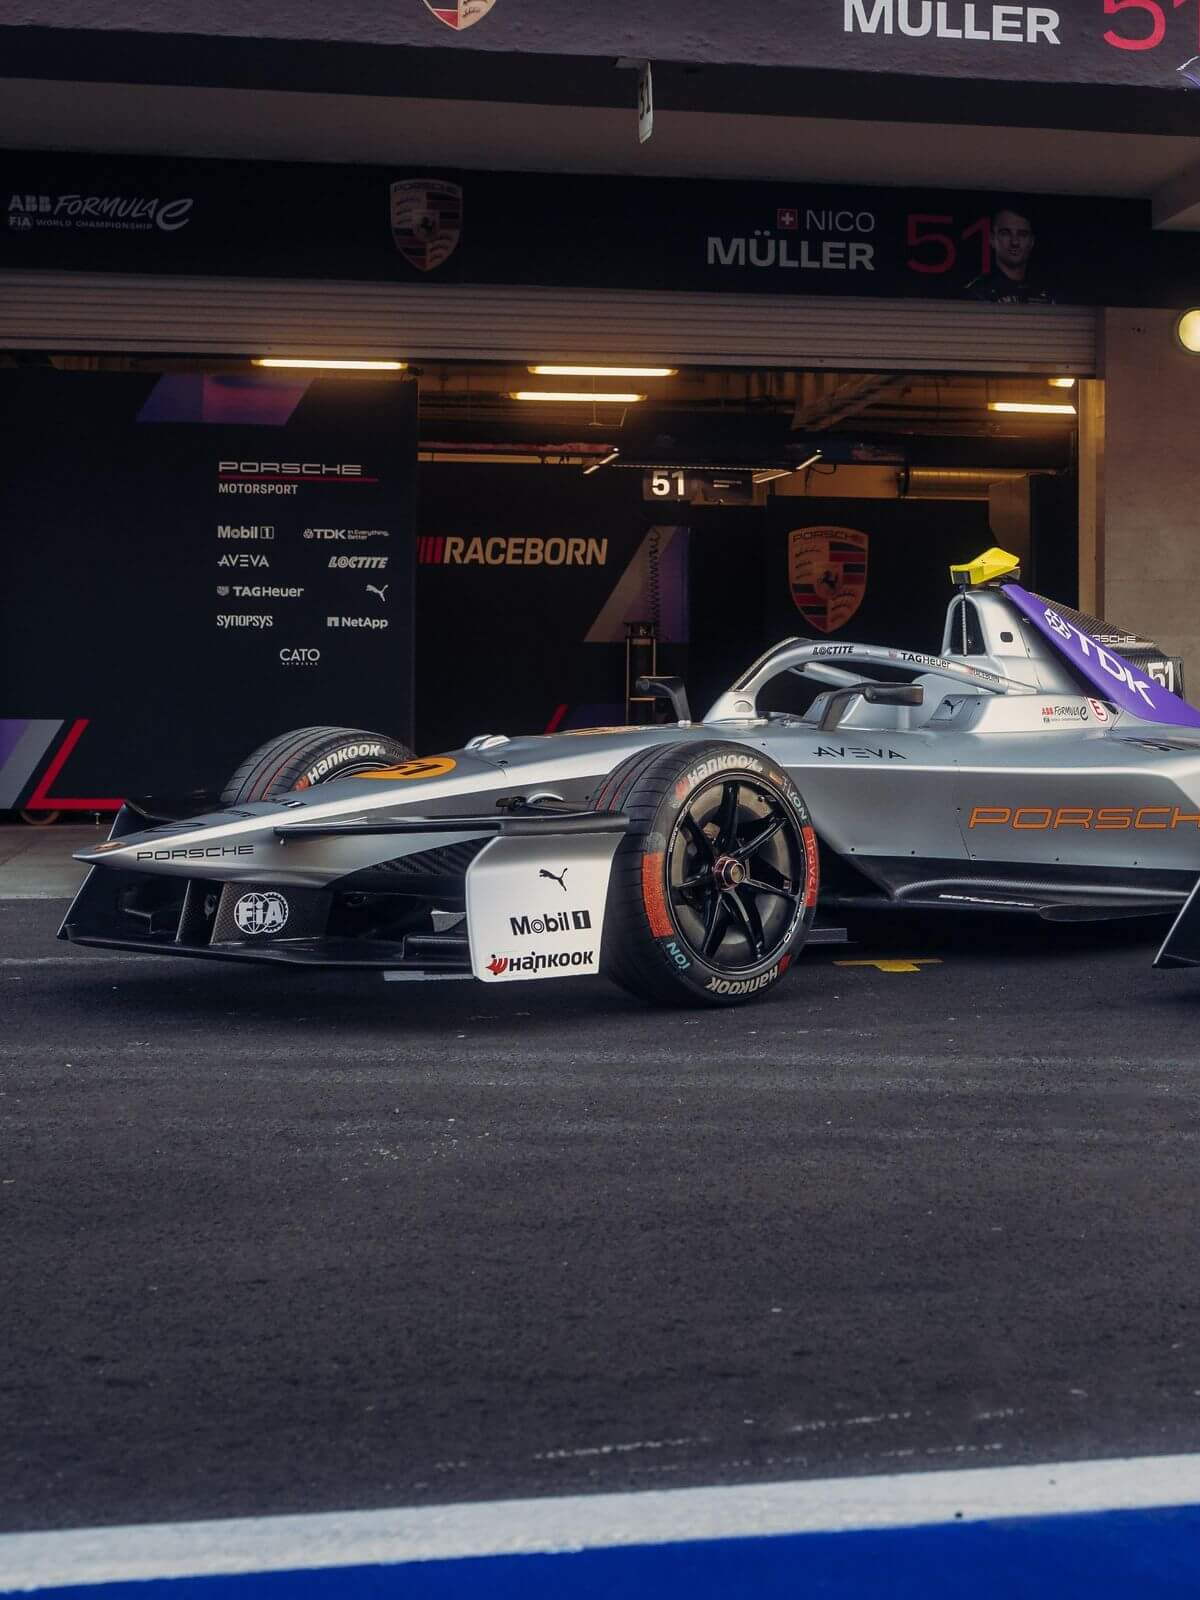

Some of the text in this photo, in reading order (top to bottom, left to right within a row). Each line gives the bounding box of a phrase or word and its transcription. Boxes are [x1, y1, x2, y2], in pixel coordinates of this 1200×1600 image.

[8, 194, 51, 213] ABB
[53, 195, 159, 219] FORMULA
[805, 209, 876, 232] NICO
[706, 229, 876, 271] MÜLLER
[905, 212, 994, 275] 51
[218, 461, 362, 475] PORSCHE
[218, 483, 299, 495] MOTORSPORT
[652, 470, 685, 496] 51
[217, 525, 275, 540] Mobil 1
[312, 528, 346, 540] TDK
[444, 536, 608, 566] RACEBORN
[216, 554, 270, 568] AVEVA
[328, 556, 389, 569] LOCTITE
[341, 616, 389, 630] NetApp
[1091, 635, 1137, 643] RSCHE
[279, 648, 321, 661] CATO
[812, 646, 854, 656] LOCTITE
[1066, 622, 1156, 710] TDK
[1148, 661, 1174, 692] 51
[813, 746, 907, 759] AVEVA
[136, 845, 254, 861] PORSCHE
[510, 910, 591, 936] Mobil 1
